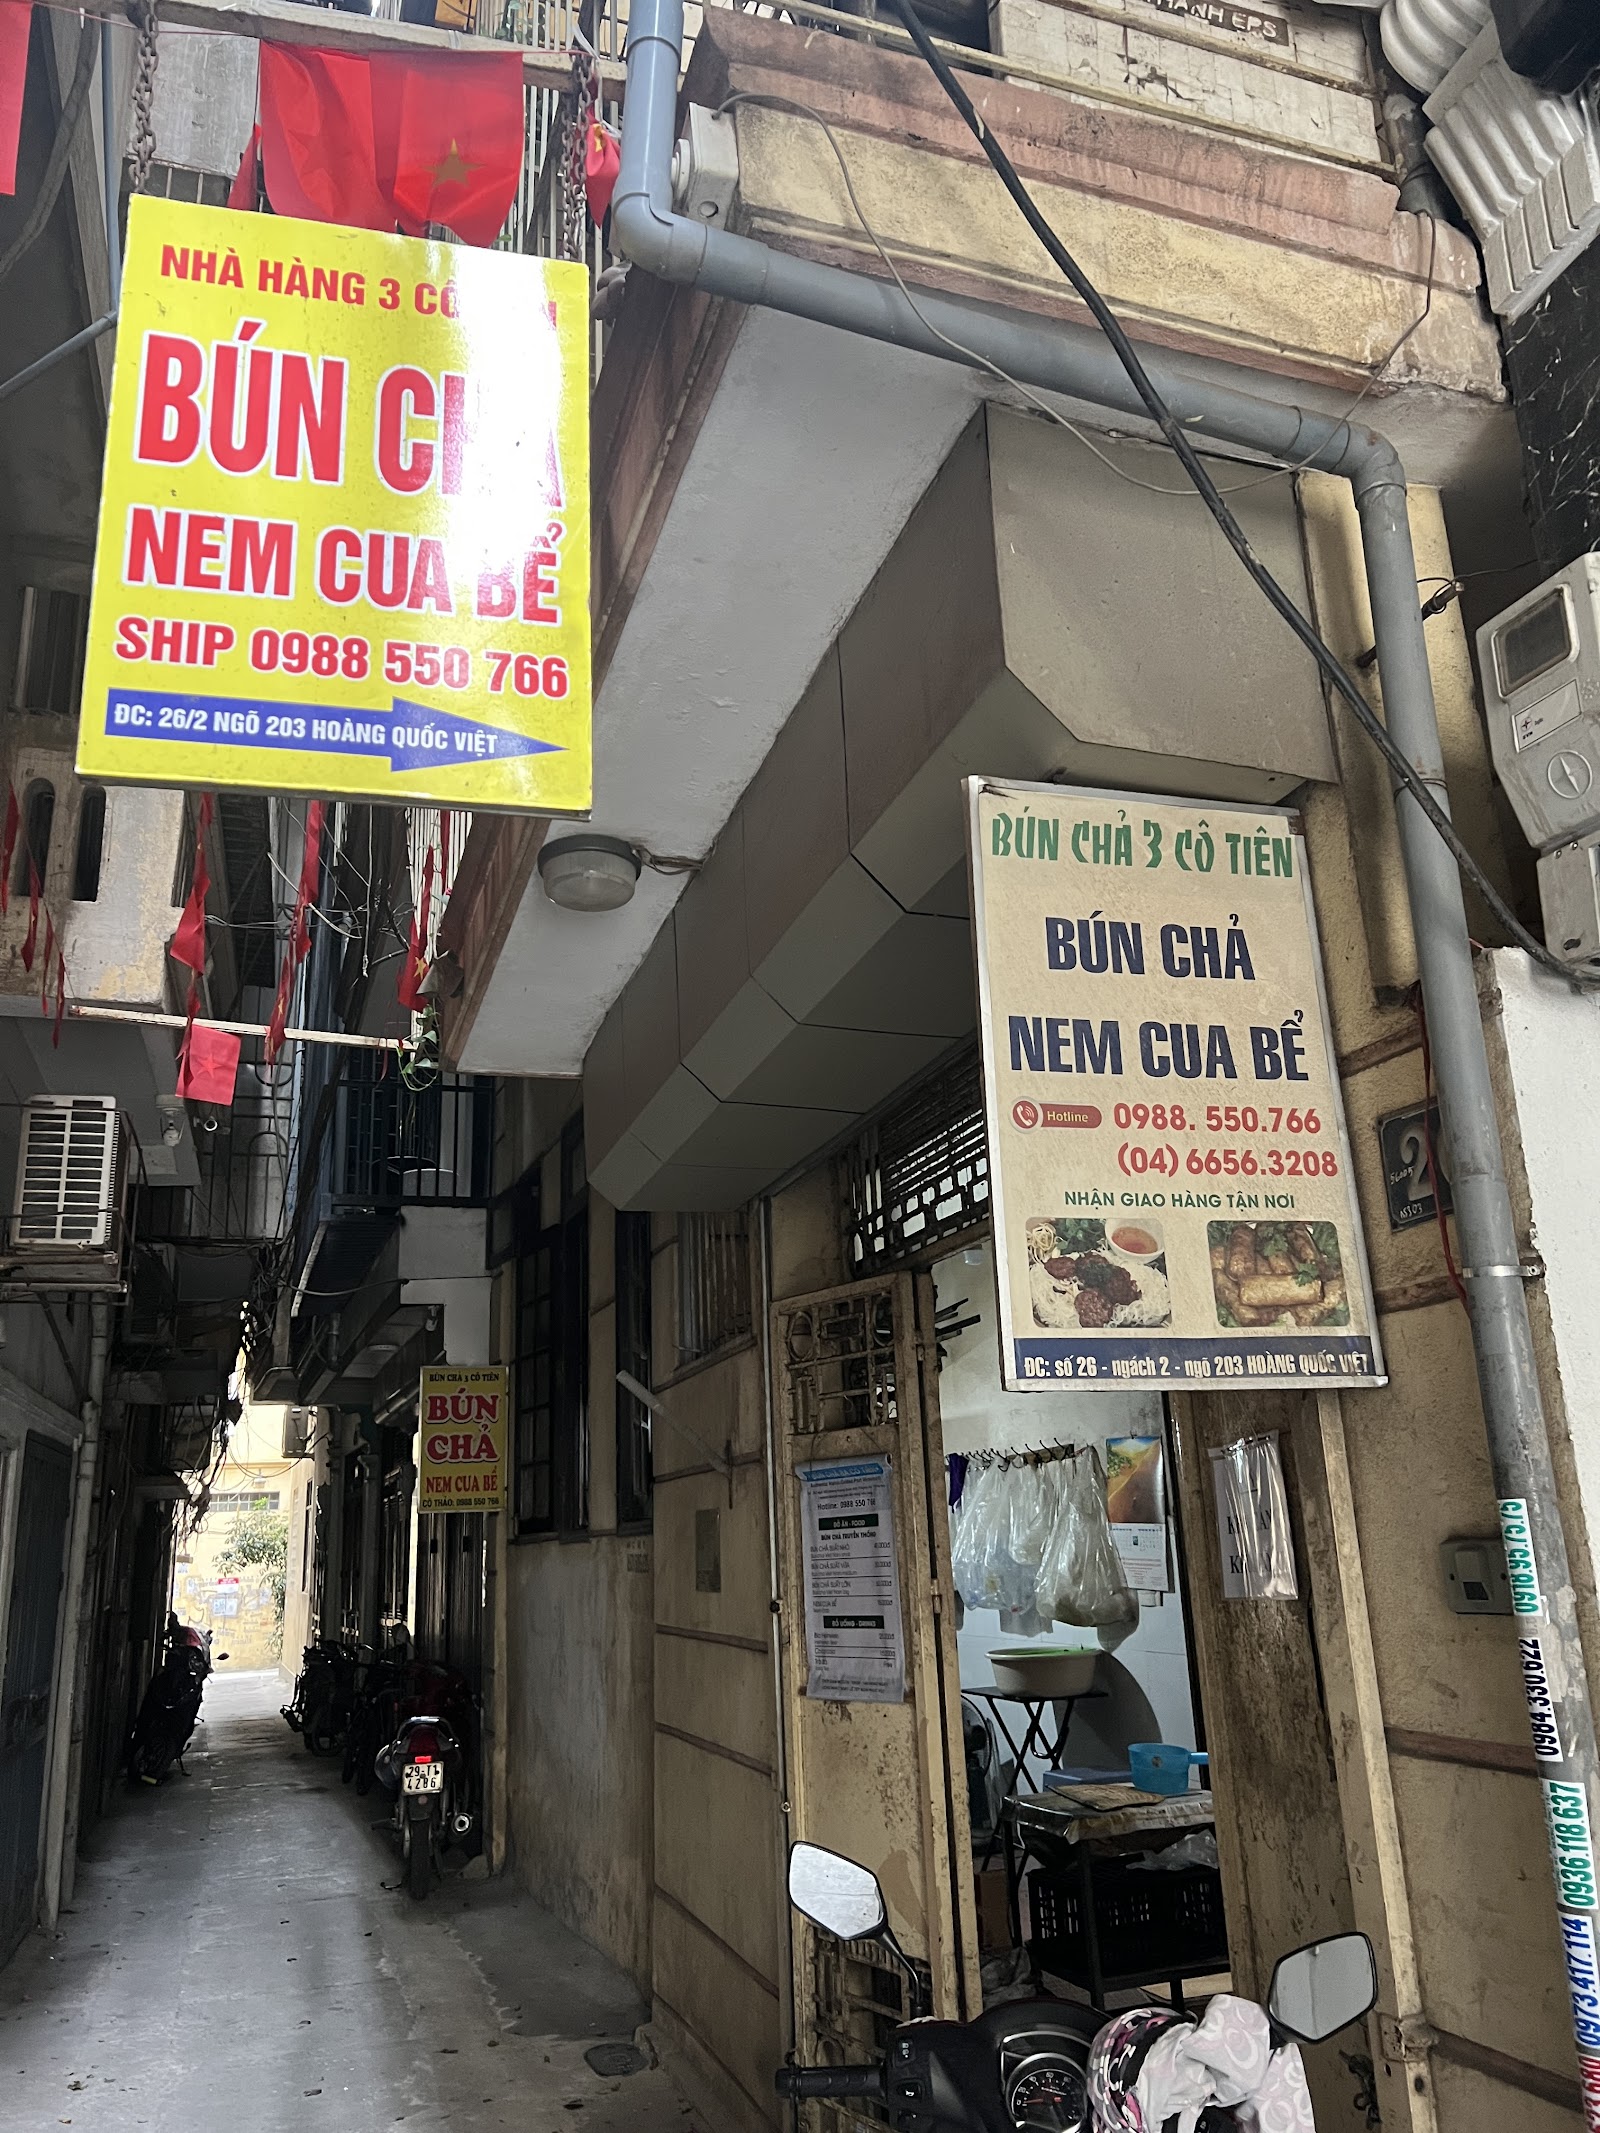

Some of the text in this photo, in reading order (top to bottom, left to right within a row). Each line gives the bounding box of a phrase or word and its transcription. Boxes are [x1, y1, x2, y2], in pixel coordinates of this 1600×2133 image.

[1232, 12, 1277, 38] EPS
[160, 244, 245, 289] NHÀ
[257, 256, 365, 306] HÀNG
[378, 277, 401, 310] 3
[138, 320, 345, 484] BÚN
[127, 507, 295, 597] NEM
[319, 528, 453, 613] CUA
[115, 616, 569, 698] SHIP 0988 550 766
[114, 702, 498, 755] ĐC: 26/2 NGÕ 203 HOÀNG QUỐC VIỆT
[992, 806, 1293, 878] BÚN CHẢ 3 CÔ TIÊN
[1045, 910, 1256, 980] BÚN CHẢ
[1008, 1009, 1310, 1081] NEM CUA BỂ
[1047, 1103, 1321, 1134] Hotline 0988. 550.766
[1118, 1142, 1339, 1178] (04) 6656.3208
[1064, 1188, 1295, 1210] NHẬN GIAO HÀNG TẬN NƠI
[1024, 1356, 1051, 1377] ĐC:
[1054, 1354, 1075, 1377] số
[1076, 1356, 1098, 1376] 26
[1111, 1355, 1156, 1379] ngách
[1159, 1356, 1171, 1376] 2
[1184, 1357, 1211, 1378] ngõ
[1214, 1355, 1244, 1376] 203
[1247, 1350, 1296, 1374] HOÀNG
[1299, 1350, 1337, 1376] QUỐC
[1338, 1351, 1368, 1375] VIỆT
[427, 1387, 499, 1421] BÚN
[426, 1424, 498, 1461] CHẢ
[426, 1465, 498, 1493] NEM CUA BỂ
[1500, 1500, 1539, 1614] 0918.95.75.75
[1519, 1638, 1560, 1757] 0984.330.622
[1549, 1781, 1596, 1907] 0936.118.637
[1561, 1916, 1600, 2046] 0973.417.114
